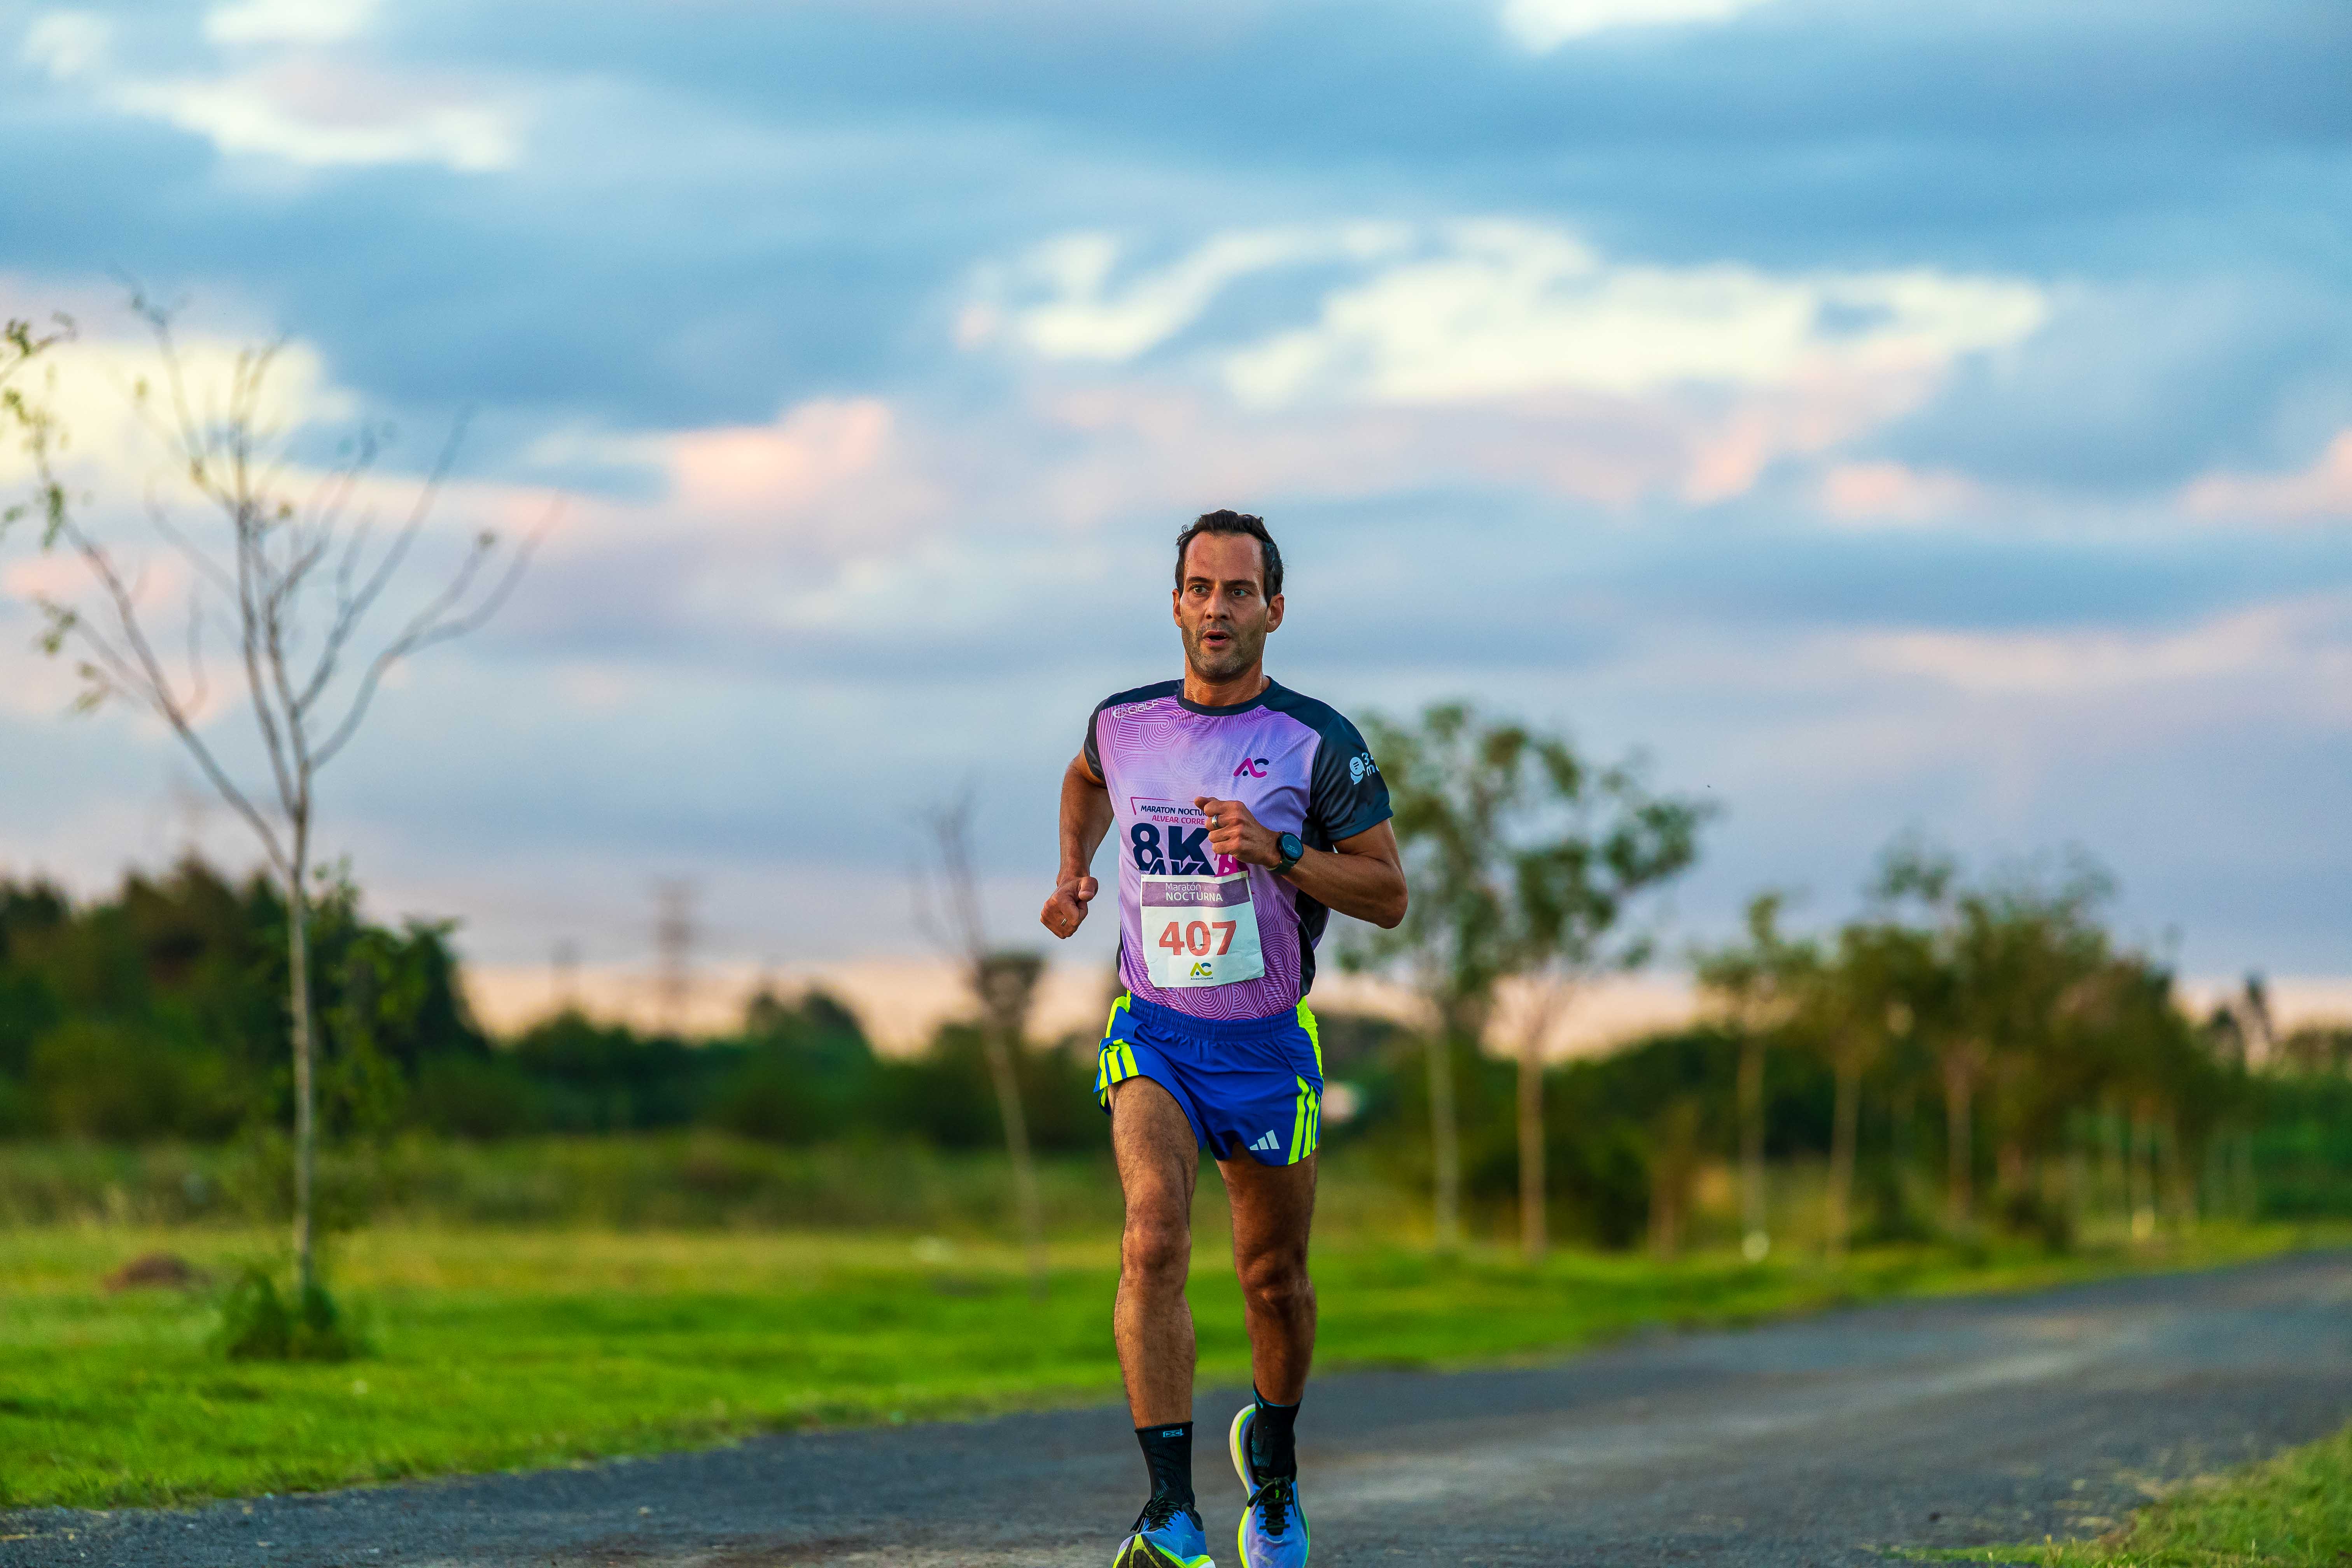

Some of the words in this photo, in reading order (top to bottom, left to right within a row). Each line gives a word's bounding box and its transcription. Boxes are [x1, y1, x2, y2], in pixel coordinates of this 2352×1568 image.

[1141, 805, 1175, 814] MARATON
[1178, 808, 1207, 816] NOCTUR
[1152, 815, 1178, 823] ALVEAR
[1130, 822, 1216, 875] 8K
[1166, 882, 1201, 891] Maratón
[1166, 892, 1223, 901] NOCTURNA
[1159, 920, 1237, 956] 407
